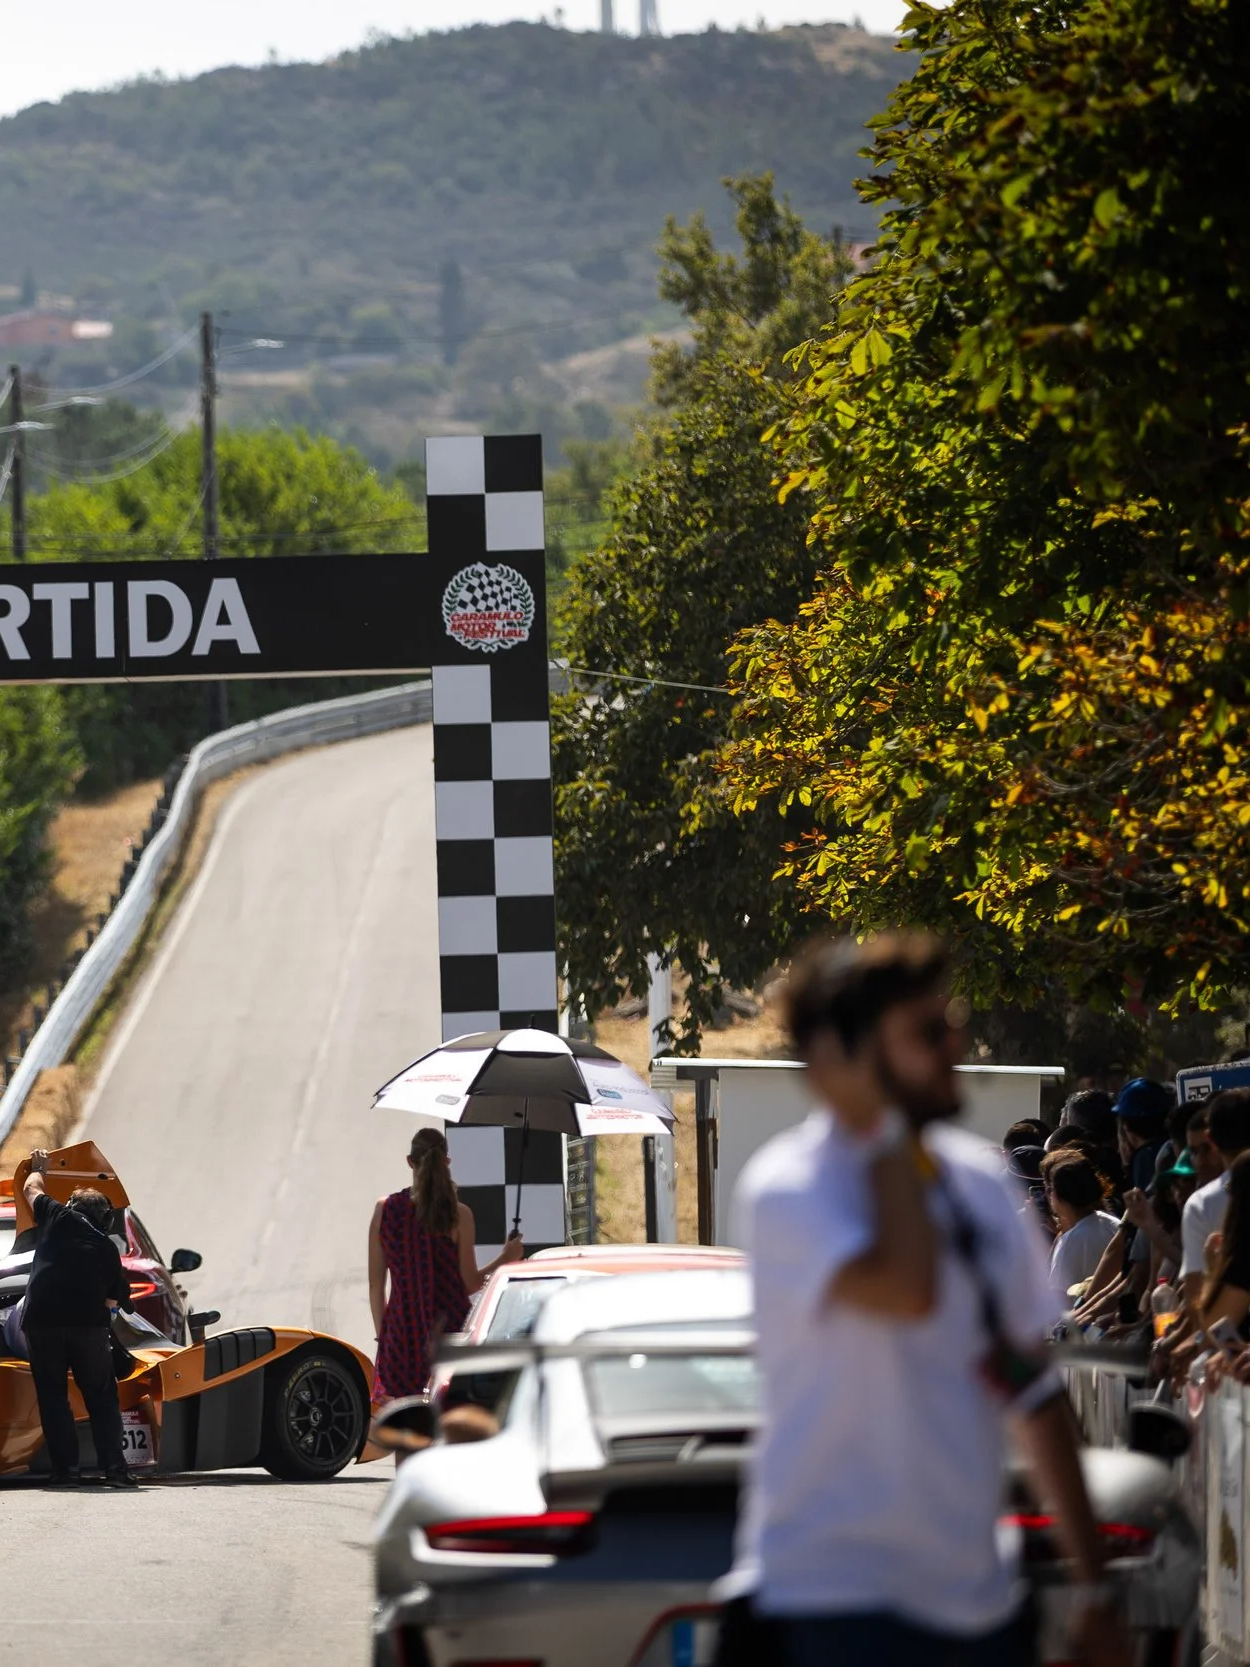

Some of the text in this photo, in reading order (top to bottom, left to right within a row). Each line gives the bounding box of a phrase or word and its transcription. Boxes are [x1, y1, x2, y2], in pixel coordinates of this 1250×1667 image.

[451, 611, 524, 622] CARAMULO
[450, 621, 496, 632] MOTOR
[463, 629, 525, 640] FESTIVAL
